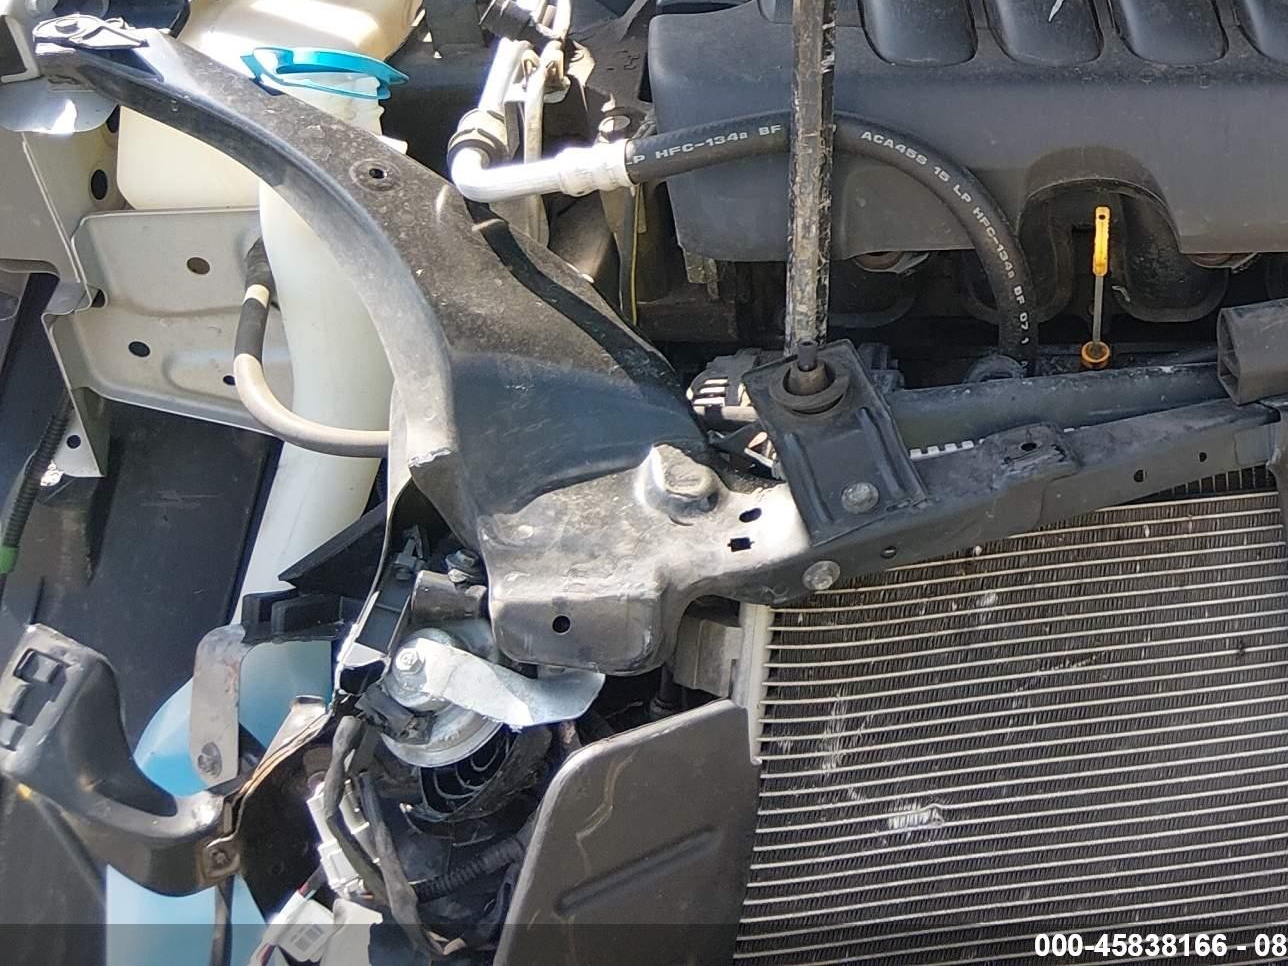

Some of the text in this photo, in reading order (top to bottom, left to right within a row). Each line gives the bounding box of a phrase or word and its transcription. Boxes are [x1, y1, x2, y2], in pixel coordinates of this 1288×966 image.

[758, 124, 782, 137] BF
[933, 166, 951, 183] 15
[953, 184, 972, 203] LP
[1020, 312, 1029, 330] 07
